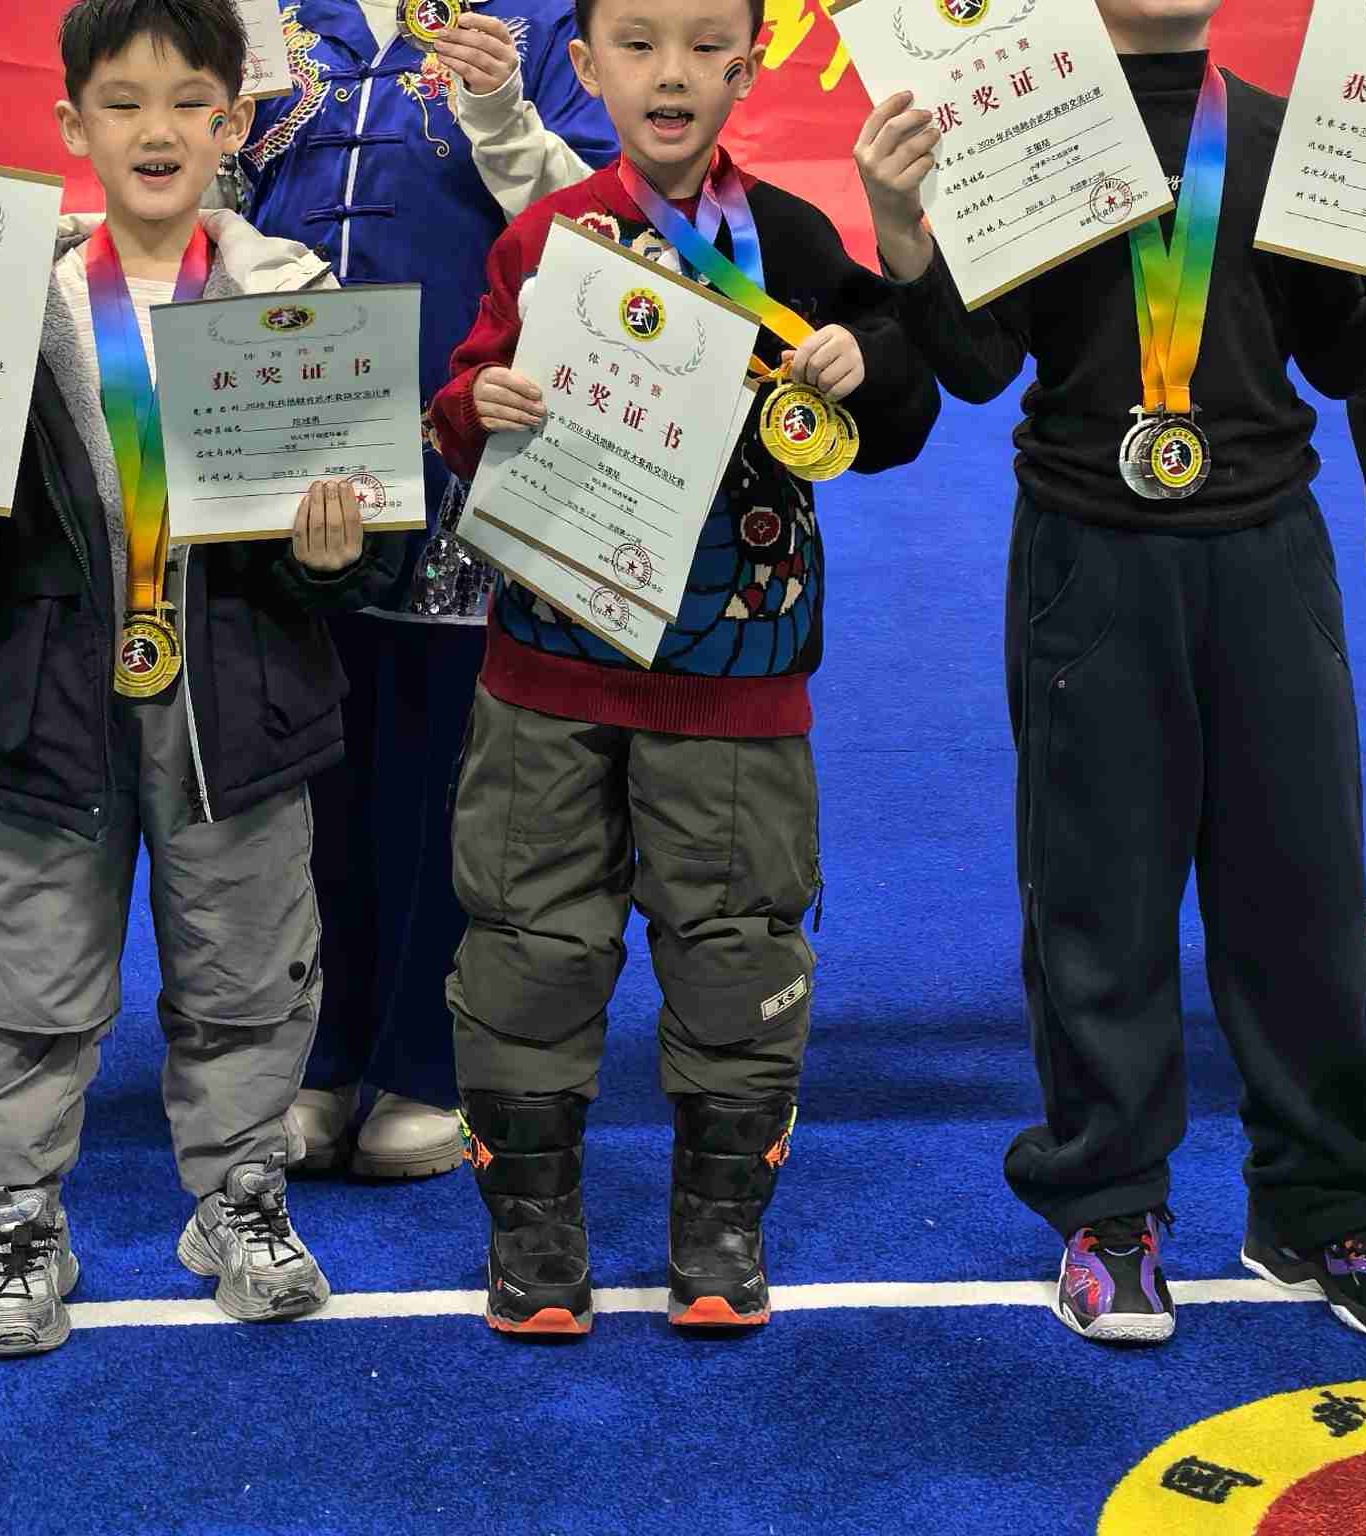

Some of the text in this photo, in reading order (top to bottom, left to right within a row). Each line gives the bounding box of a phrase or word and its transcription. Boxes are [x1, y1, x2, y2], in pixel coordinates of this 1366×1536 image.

[934, 50, 1077, 134] 获奖证书
[950, 37, 1031, 83] 体育竞赛
[212, 357, 371, 391] 获奖证书
[552, 364, 685, 451] 获奖证书
